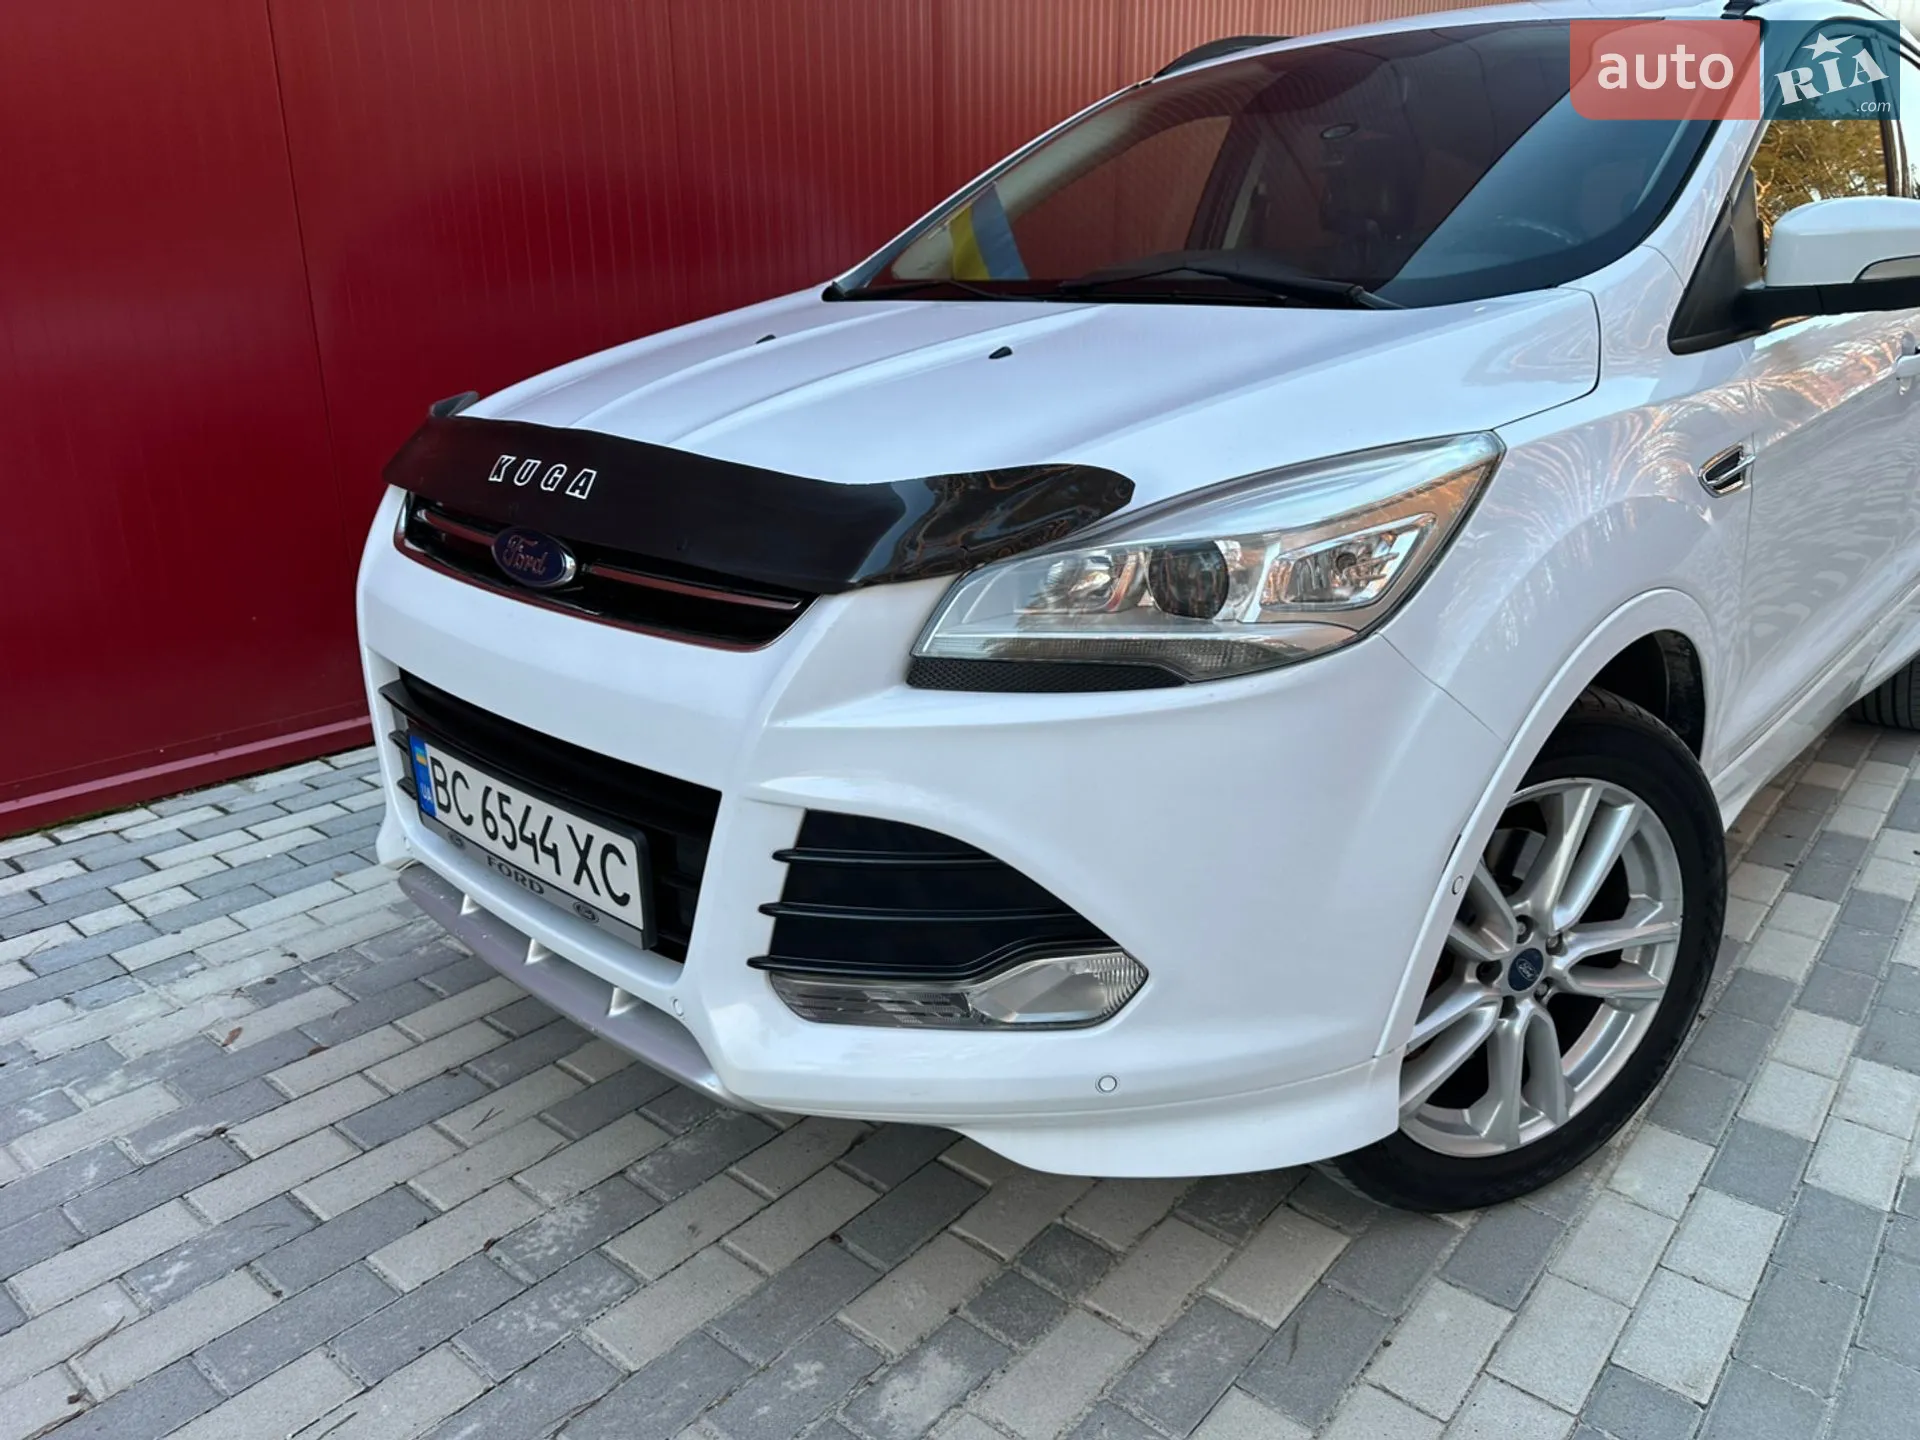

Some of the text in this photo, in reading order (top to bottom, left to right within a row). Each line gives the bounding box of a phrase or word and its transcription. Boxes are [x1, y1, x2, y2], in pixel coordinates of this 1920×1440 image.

[488, 454, 598, 500] KUGA
[502, 534, 549, 576] Ford
[430, 756, 631, 907] BC 6544 XC
[486, 855, 545, 896] FORD
